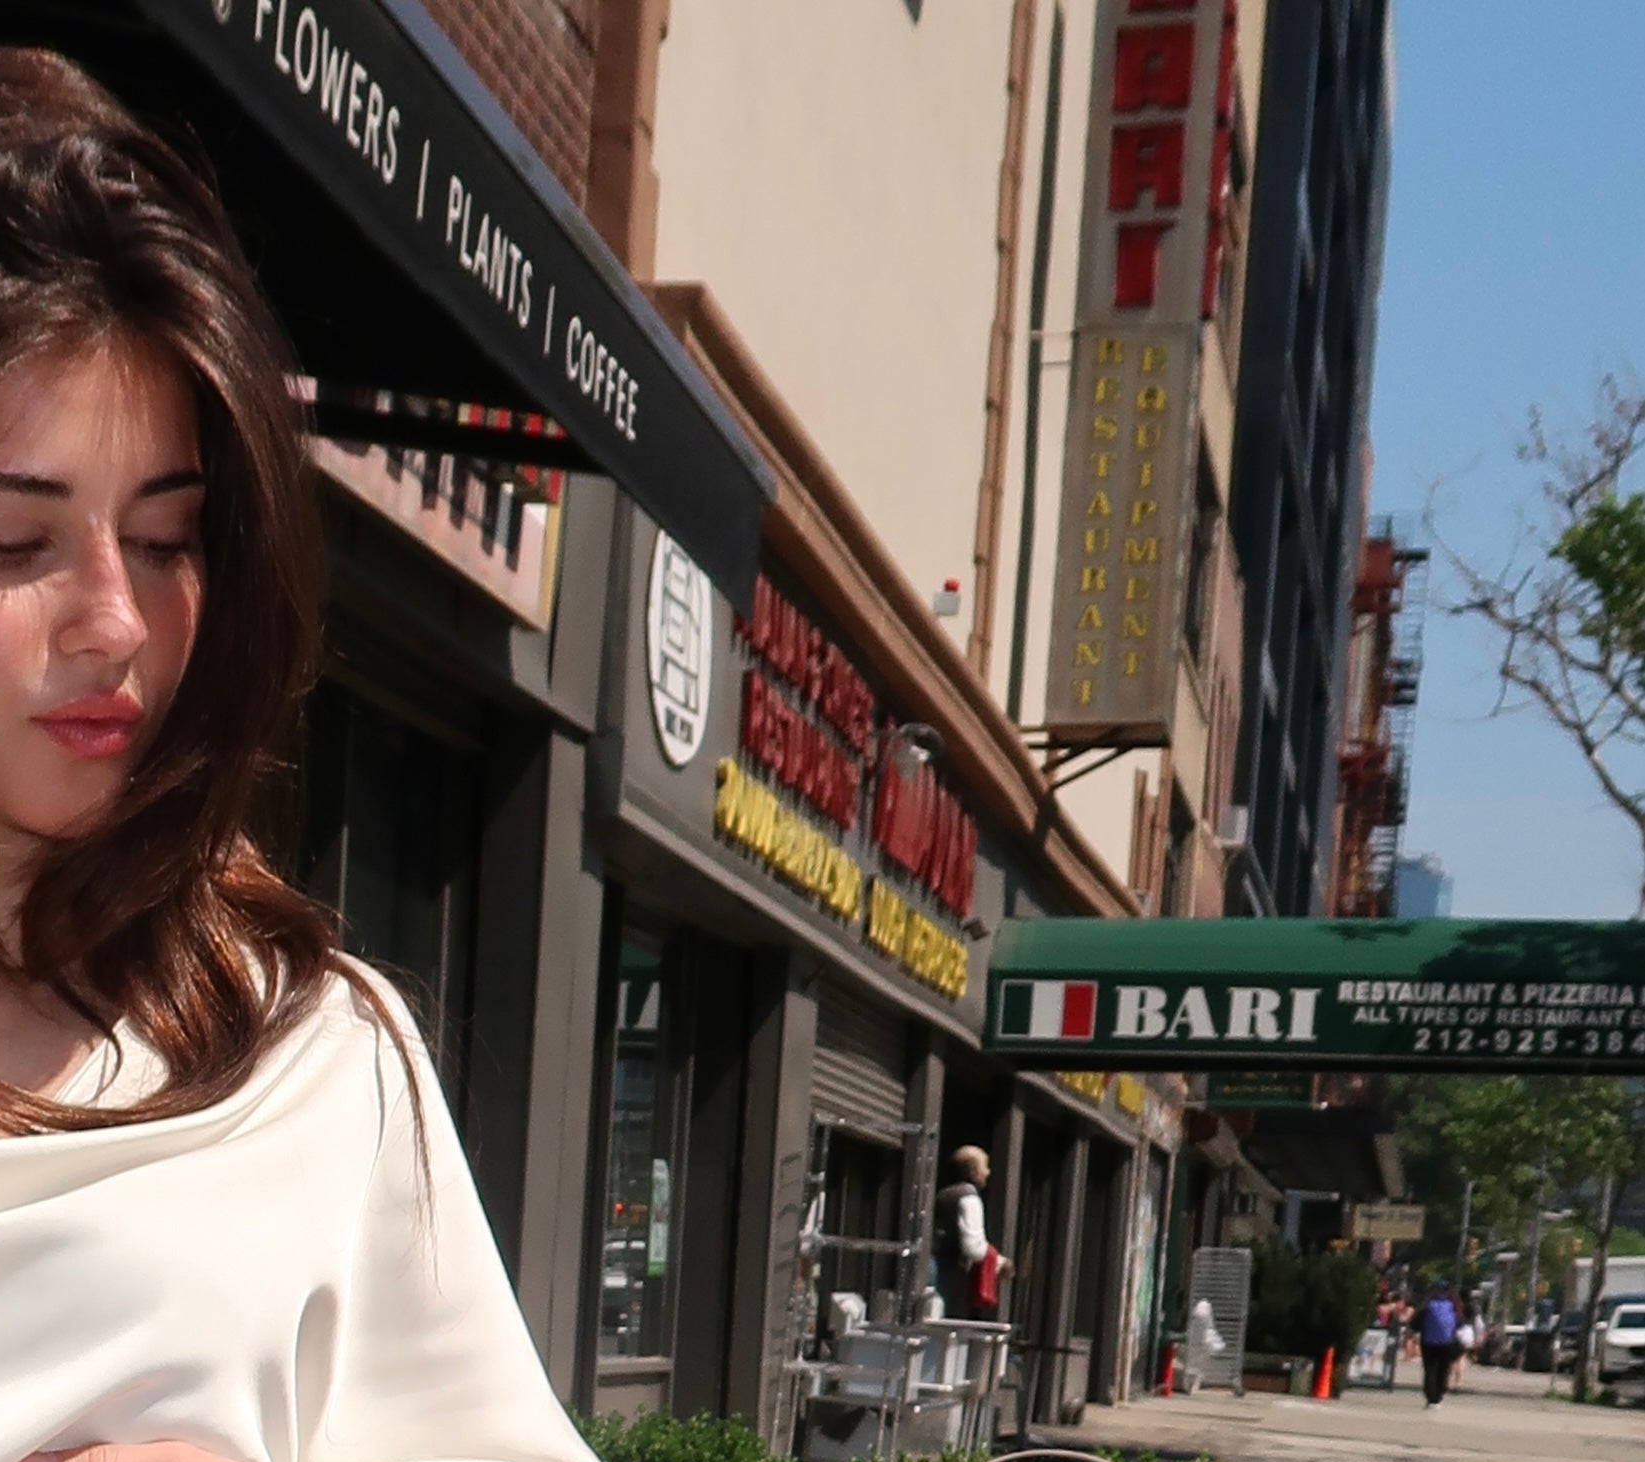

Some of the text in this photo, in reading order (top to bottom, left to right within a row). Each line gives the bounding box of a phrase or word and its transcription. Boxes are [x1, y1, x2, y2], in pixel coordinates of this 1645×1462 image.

[446, 174, 533, 328] PLANTS
[566, 315, 639, 441] COFFEE
[1072, 339, 1123, 705] RESTAURANT
[1121, 346, 1168, 678] EQUIPMENT
[1111, 985, 1323, 1042] BARI
[1338, 981, 1496, 1003] RESTAURANT
[1500, 983, 1517, 1004] &
[1523, 984, 1635, 1006] PIZZERIA
[1354, 1005, 1390, 1024] ALL
[1398, 1006, 1459, 1026] TYPES
[1465, 1007, 1491, 1026] OF
[1497, 1007, 1625, 1027] RESTAURANT
